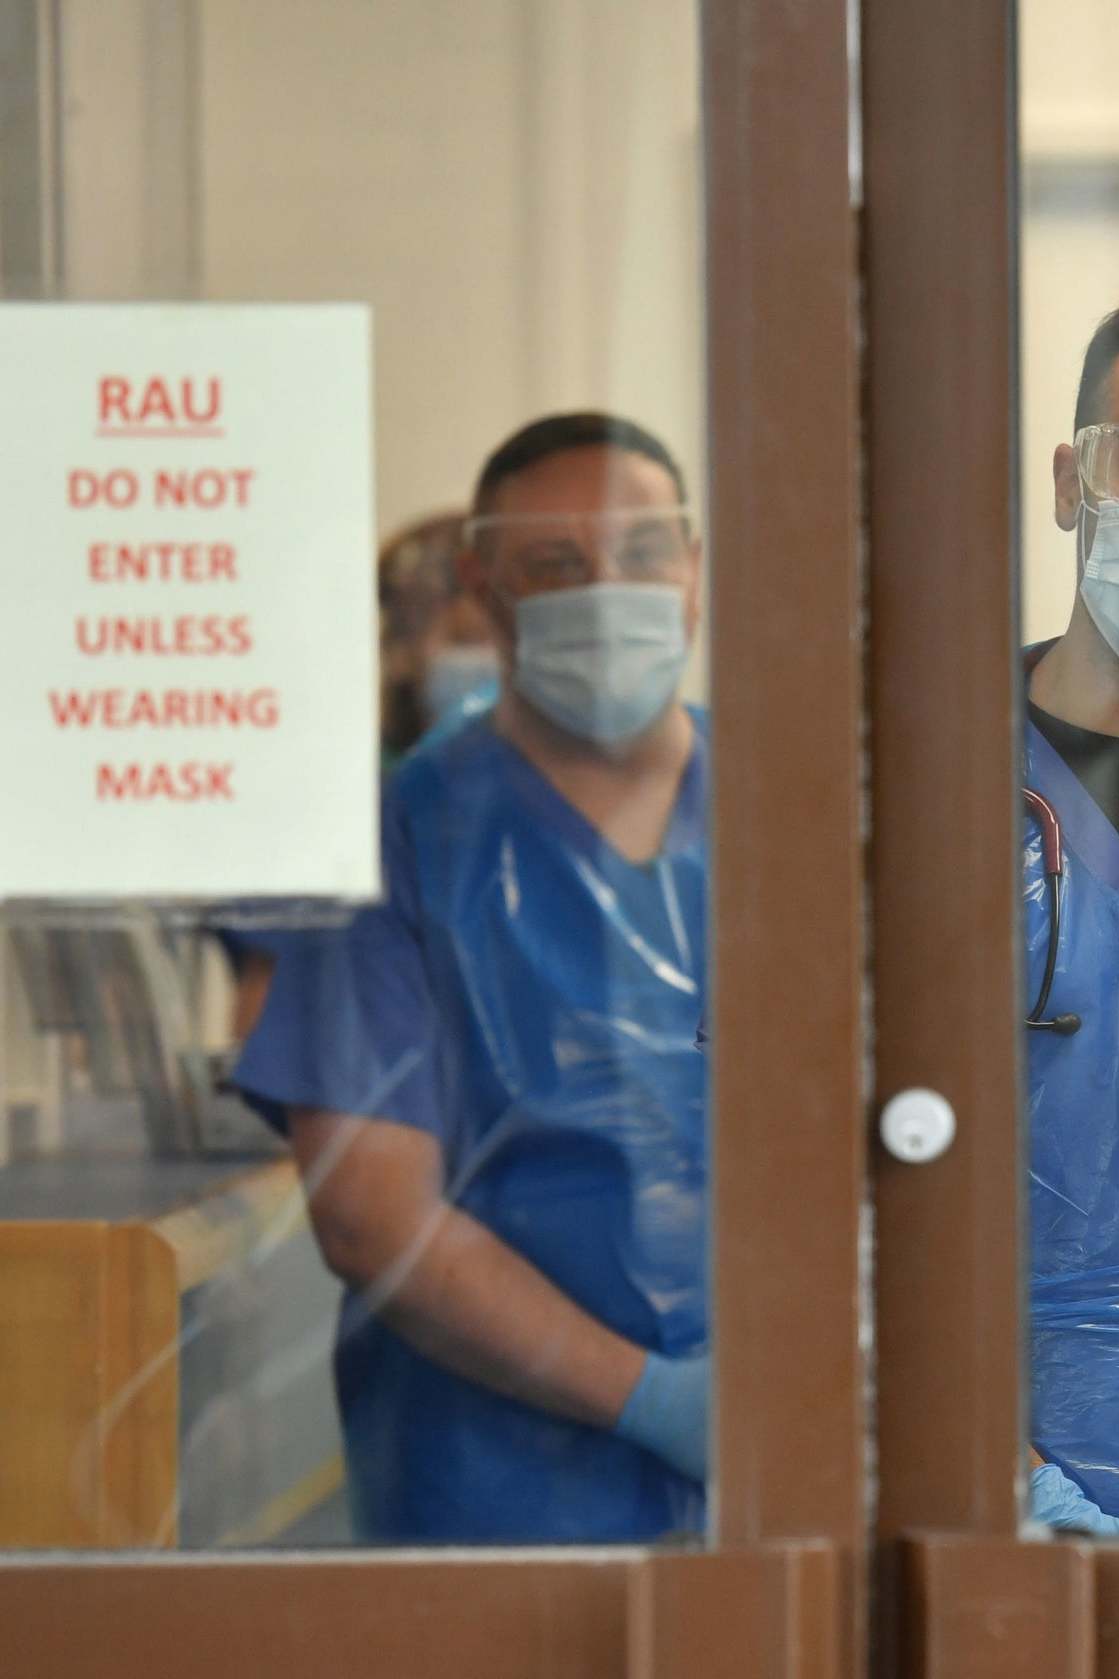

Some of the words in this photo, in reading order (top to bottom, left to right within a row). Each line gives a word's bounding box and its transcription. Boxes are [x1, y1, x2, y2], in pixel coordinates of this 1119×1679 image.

[98, 376, 222, 425] RAU
[66, 469, 139, 509] DO
[154, 469, 254, 509] NOT
[88, 542, 237, 582] ENTER
[75, 616, 252, 655] UNLESS
[48, 690, 279, 729] WEARING
[96, 763, 234, 801] MASK
